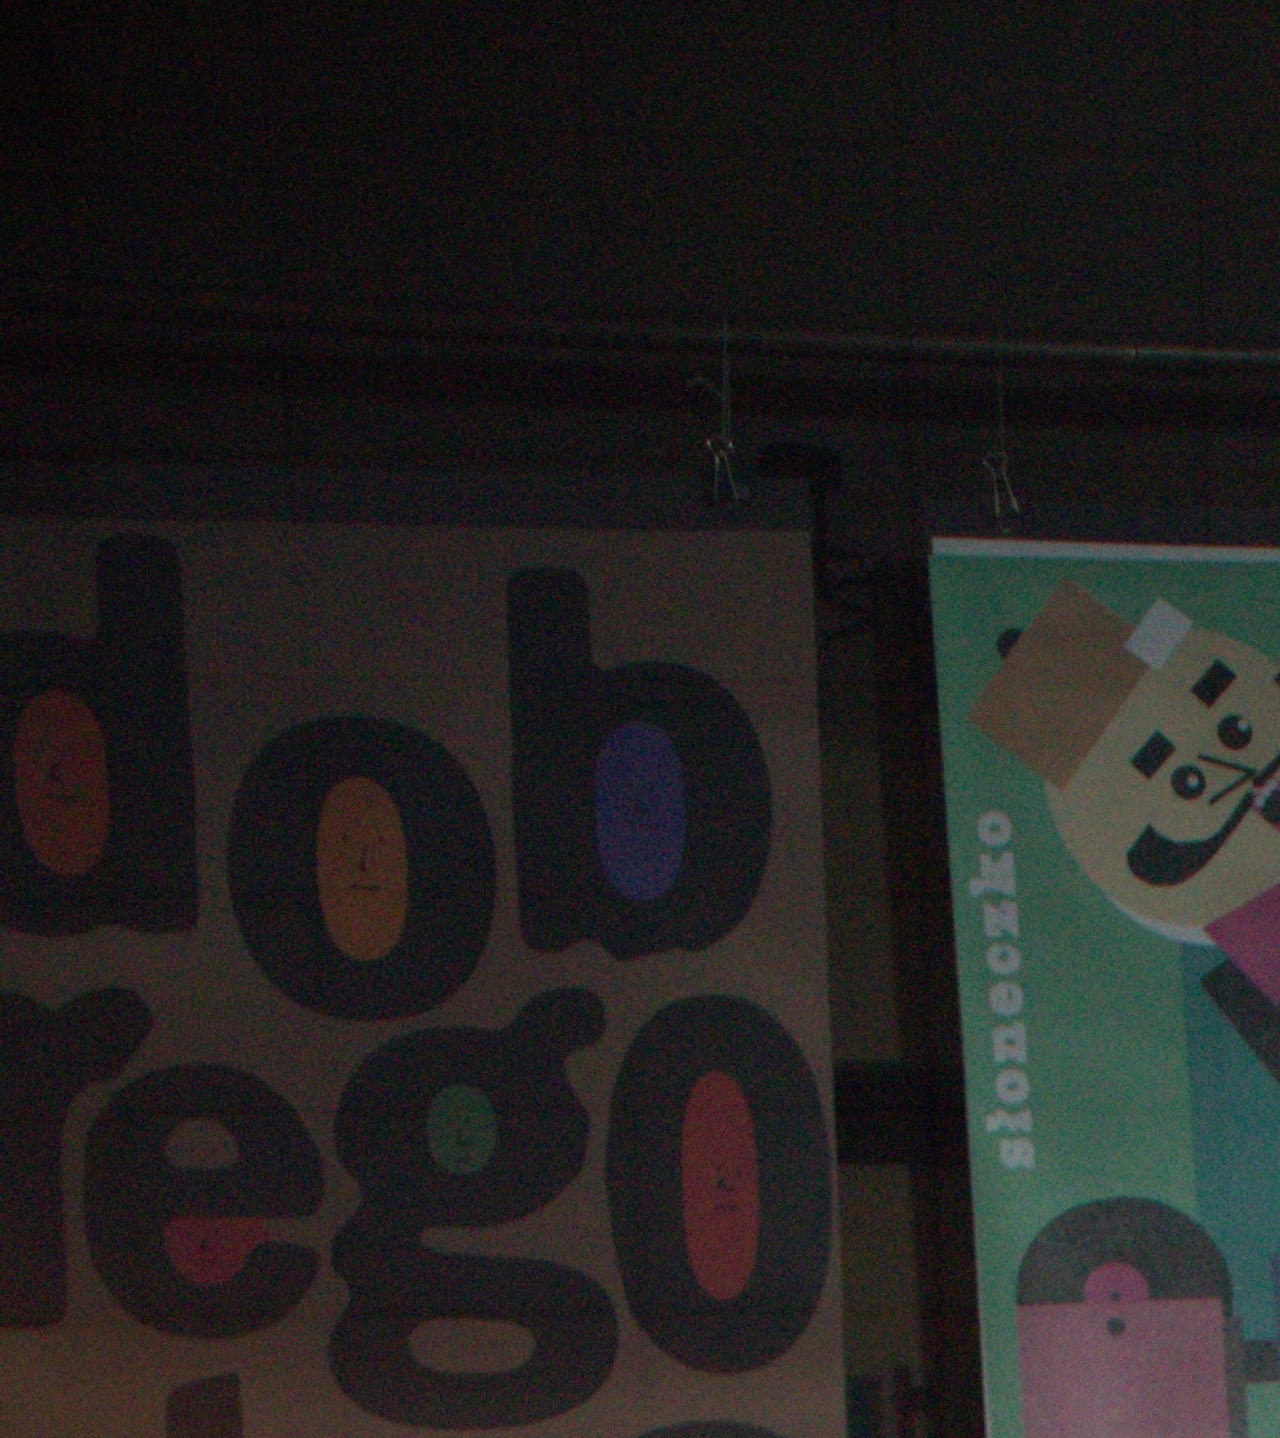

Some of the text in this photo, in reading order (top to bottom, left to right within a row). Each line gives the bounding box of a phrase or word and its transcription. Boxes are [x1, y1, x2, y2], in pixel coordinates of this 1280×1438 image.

[0, 533, 772, 1021] dob
[969, 811, 1034, 1170] słoneczko
[0, 988, 838, 1430] rego
